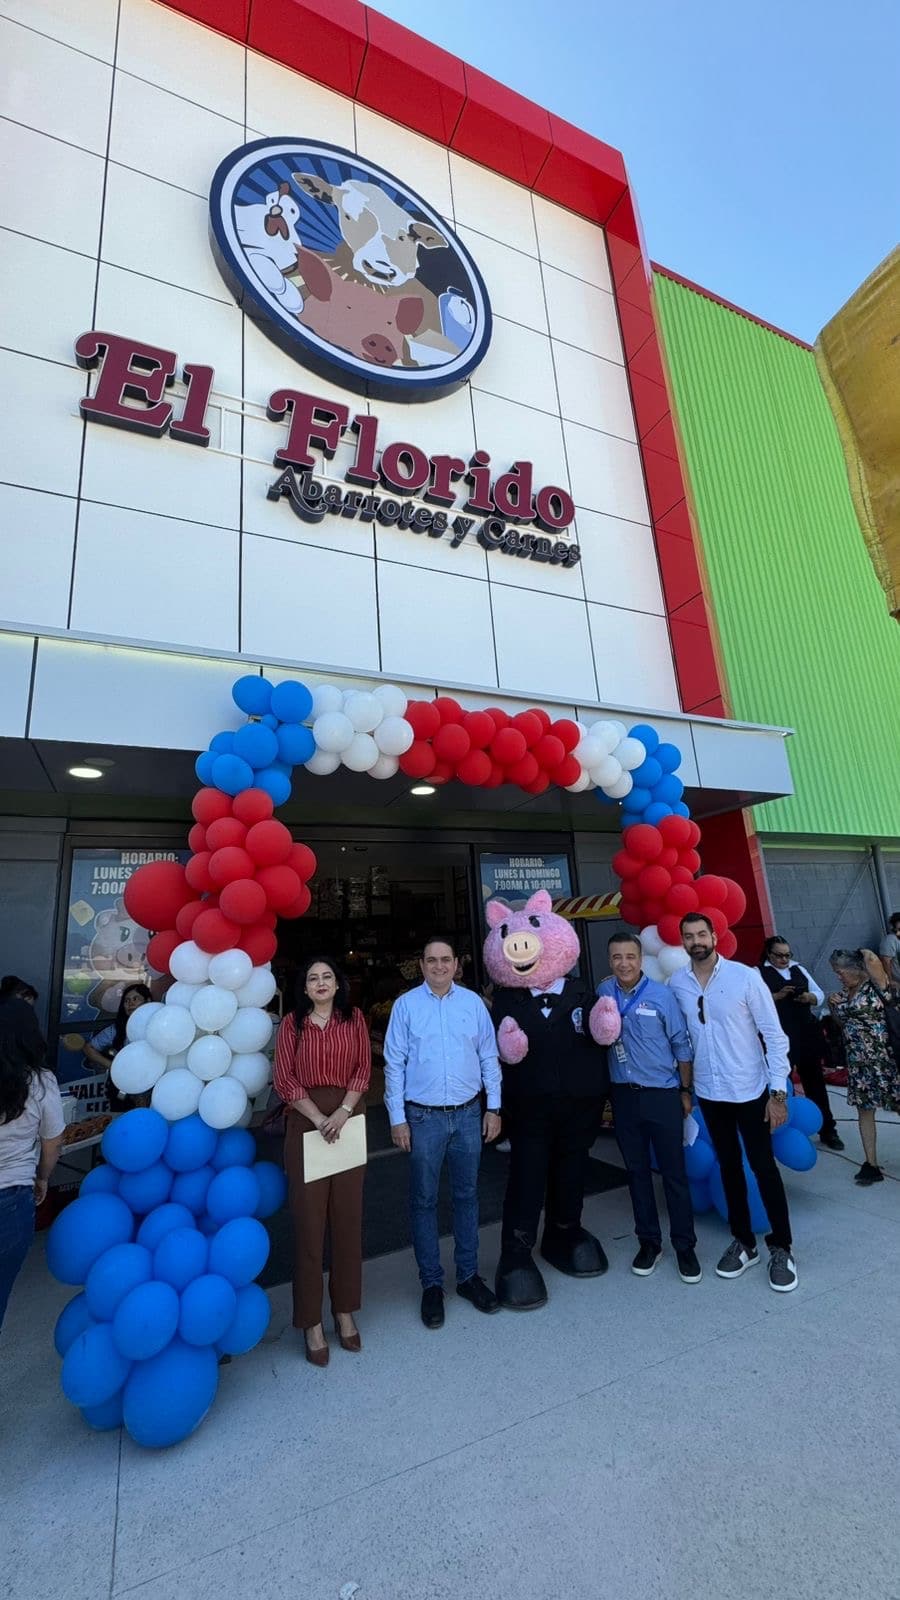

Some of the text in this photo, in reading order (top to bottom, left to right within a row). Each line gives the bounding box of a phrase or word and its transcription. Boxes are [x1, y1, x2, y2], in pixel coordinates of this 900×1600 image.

[74, 330, 575, 531] El Florido
[268, 465, 581, 566] Abarrotes y Carnes
[509, 857, 545, 867] HORARIO:
[94, 867, 133, 879] LUNES
[494, 868, 560, 879] LUNES A DOMINGO
[494, 880, 523, 890] 7:00AM
[524, 880, 530, 890] A
